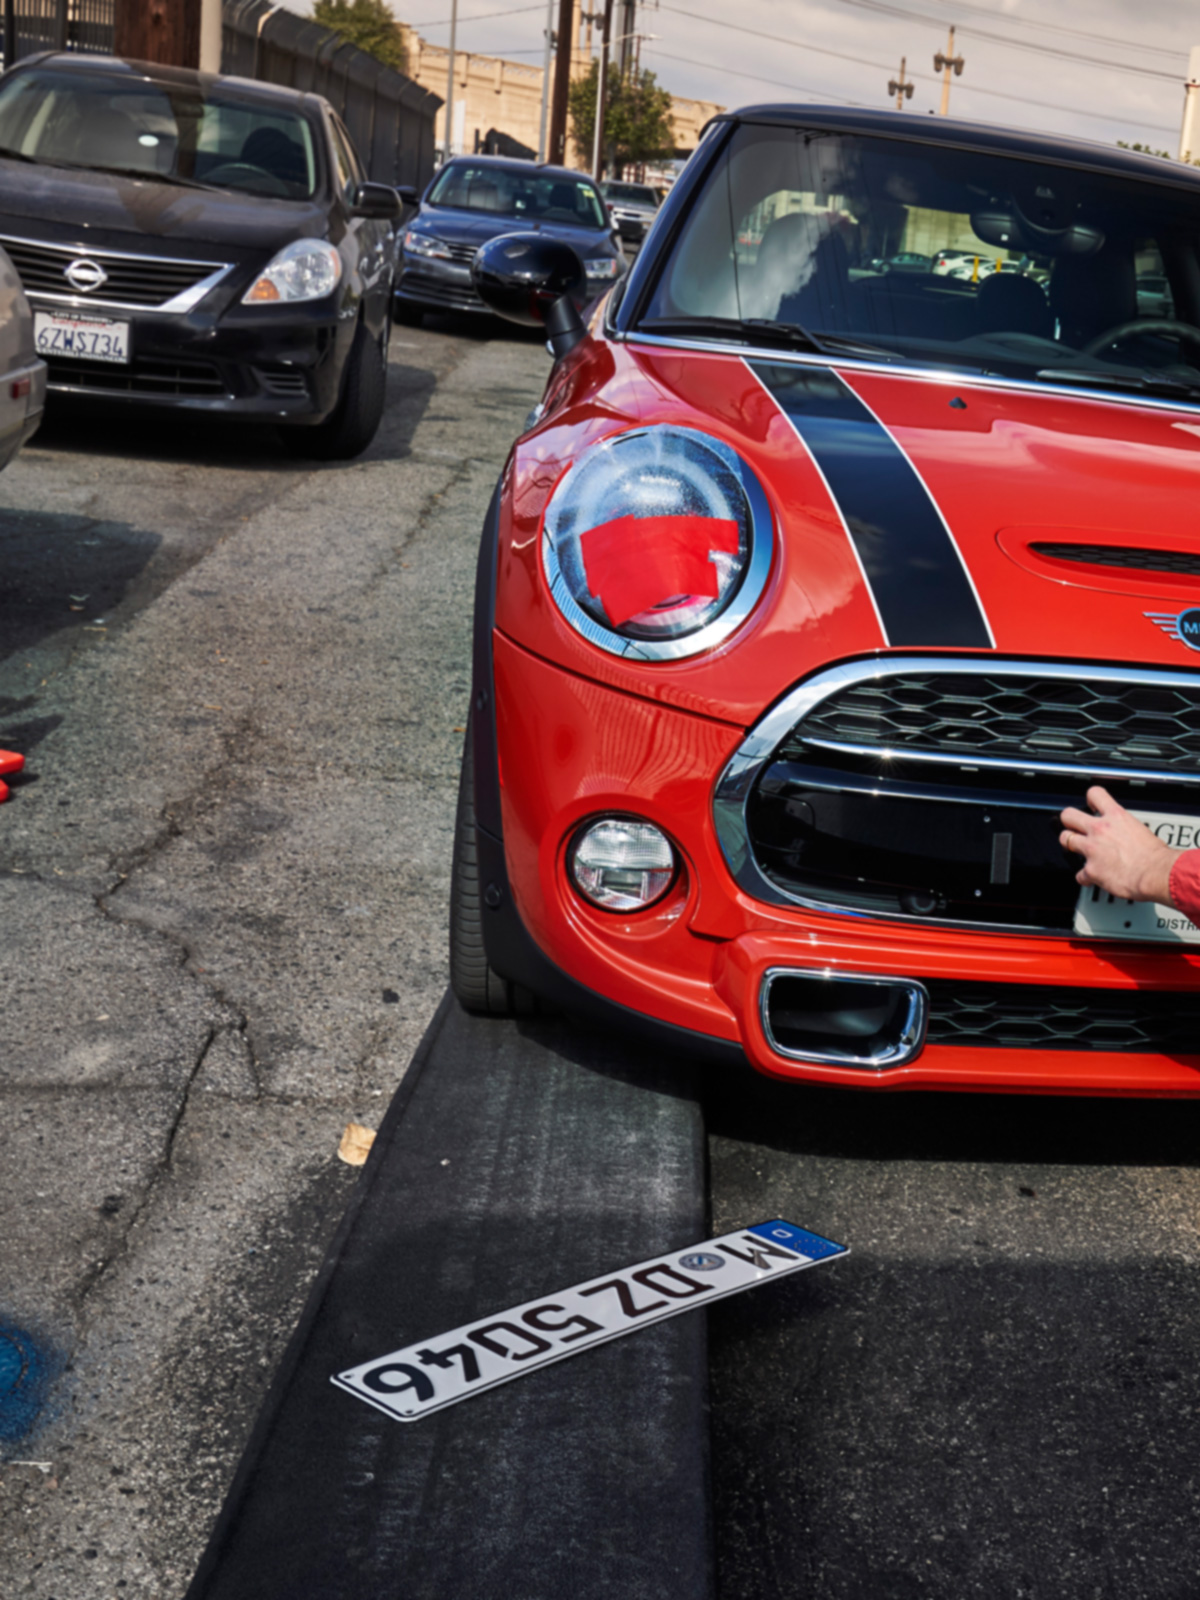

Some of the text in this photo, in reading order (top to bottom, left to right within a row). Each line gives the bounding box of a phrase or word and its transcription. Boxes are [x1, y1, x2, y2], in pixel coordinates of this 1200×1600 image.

[37, 326, 123, 357] 6ZWS734
[1156, 917, 1199, 931] DISTR
[362, 1234, 800, 1402] M DZ 5046
